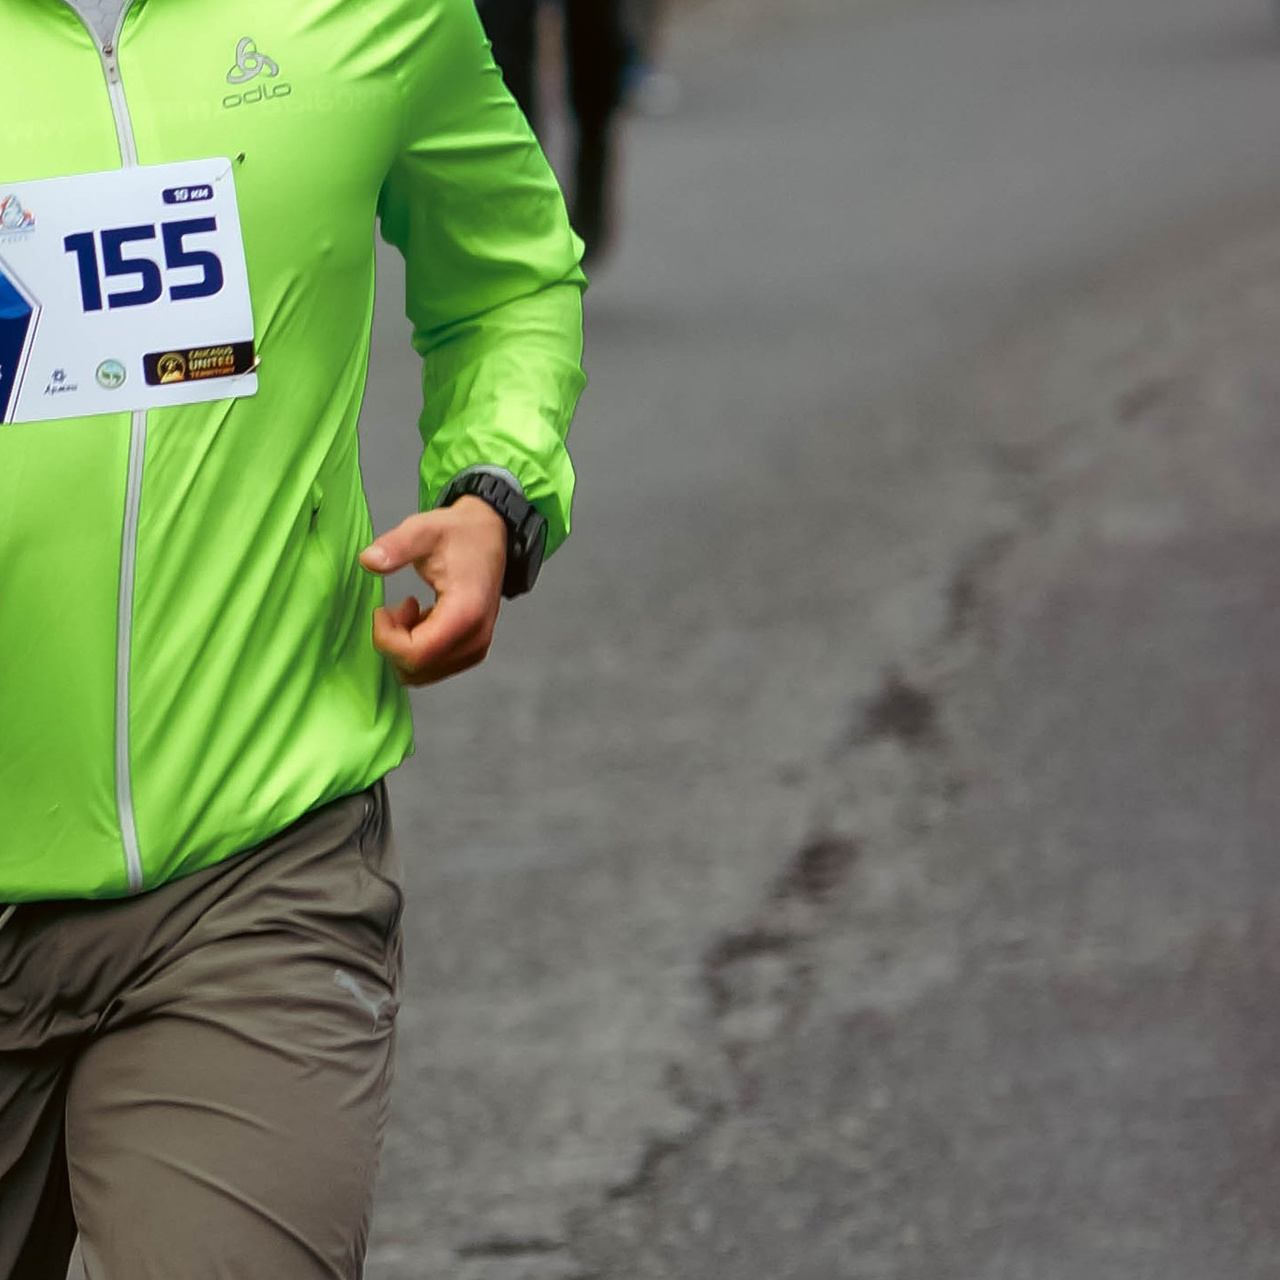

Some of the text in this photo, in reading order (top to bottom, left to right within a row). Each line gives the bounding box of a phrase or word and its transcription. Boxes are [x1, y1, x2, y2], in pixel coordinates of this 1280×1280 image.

[222, 82, 291, 109] odlo
[173, 188, 189, 201] 10
[64, 216, 224, 313] 155
